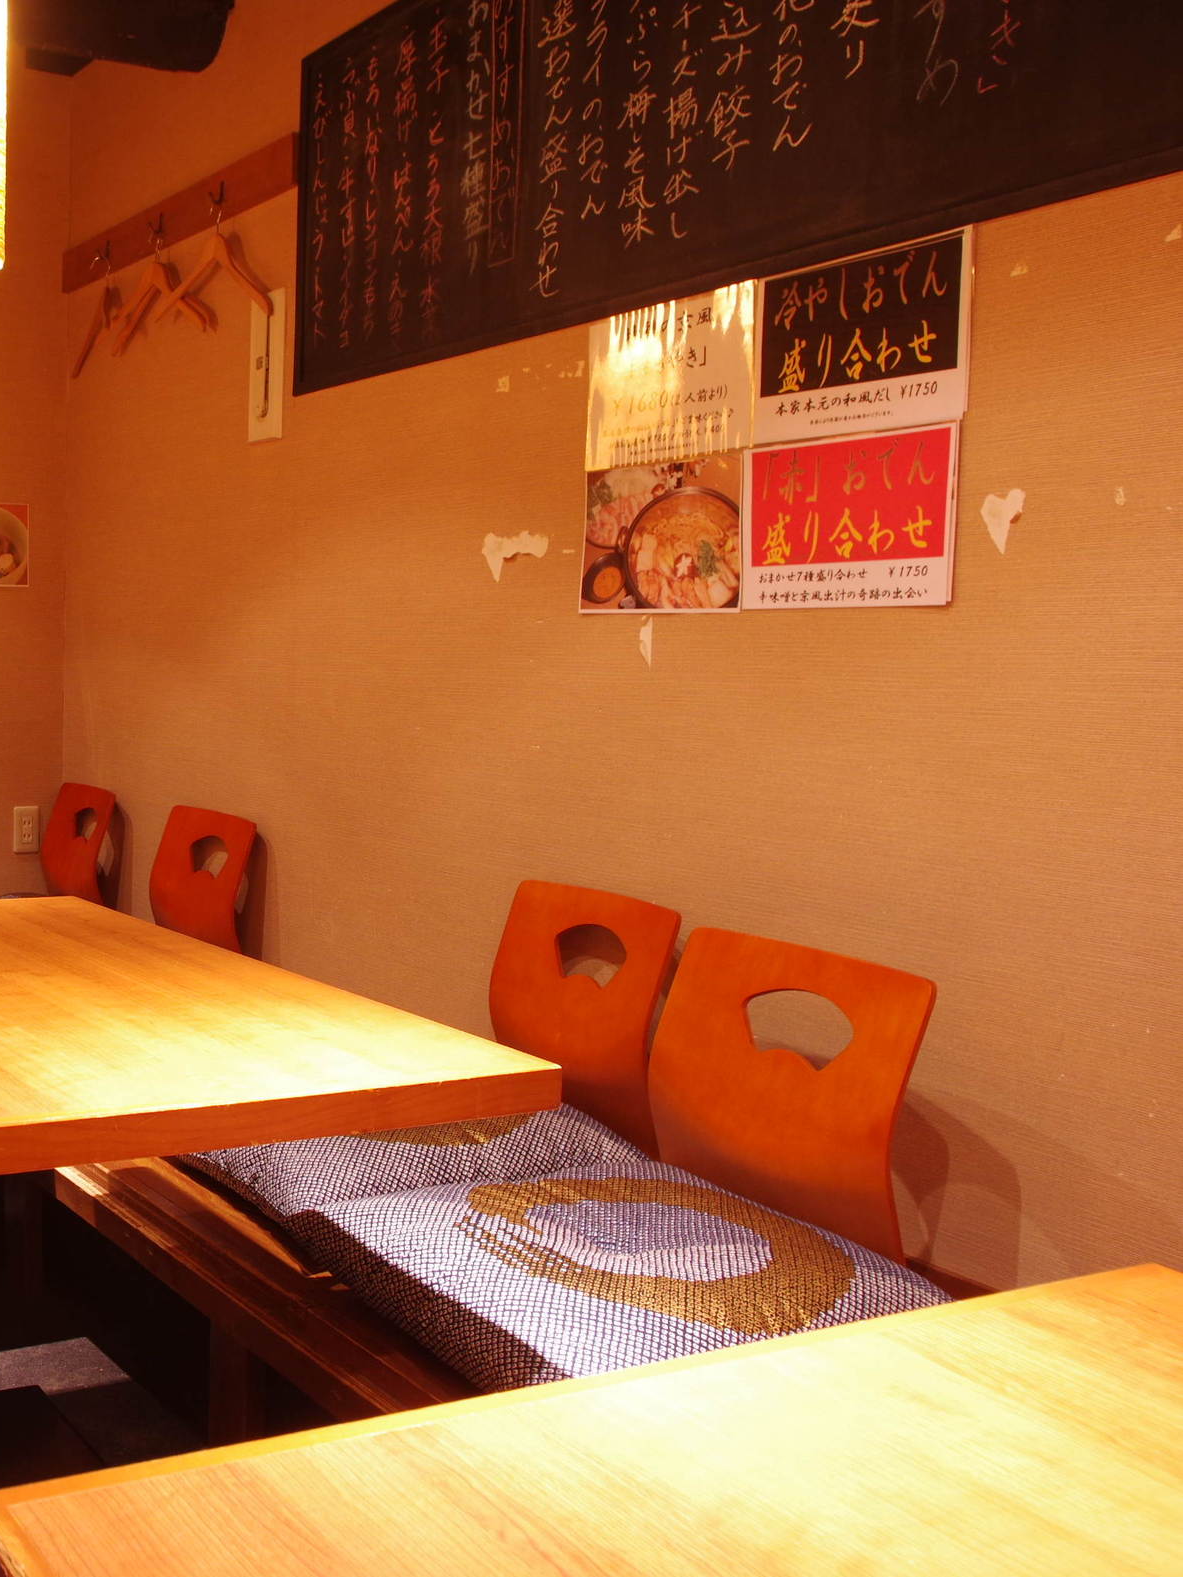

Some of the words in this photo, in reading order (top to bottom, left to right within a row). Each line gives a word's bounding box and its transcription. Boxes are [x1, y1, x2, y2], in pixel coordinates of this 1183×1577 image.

[774, 250, 949, 331] 冷やしおでん
[777, 319, 939, 394] 盛り合わせ
[761, 505, 934, 567] 盛り合わせ
